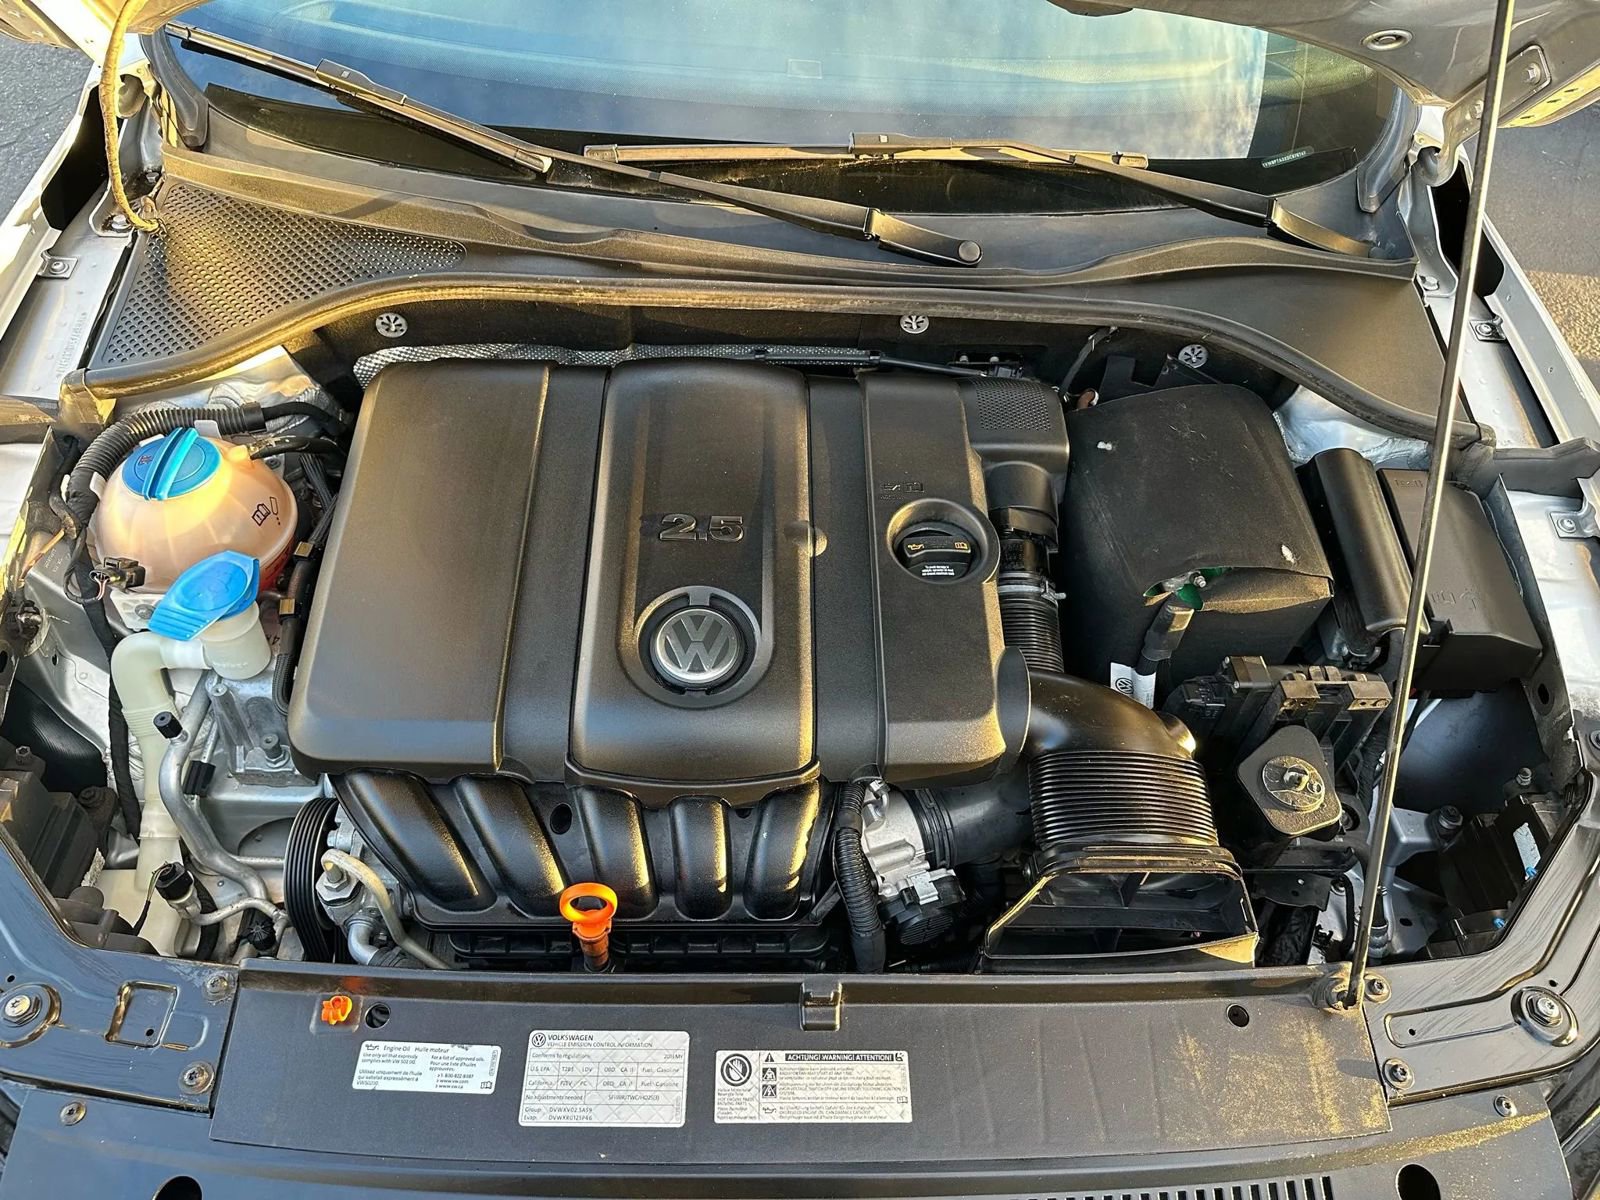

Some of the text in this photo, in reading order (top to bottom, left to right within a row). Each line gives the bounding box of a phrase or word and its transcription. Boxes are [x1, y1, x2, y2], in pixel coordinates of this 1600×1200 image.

[659, 513, 744, 542] 2.5
[383, 1045, 401, 1053] Engine
[788, 1053, 820, 1061] ACHTUNG!
[821, 1053, 855, 1061] WARNING!
